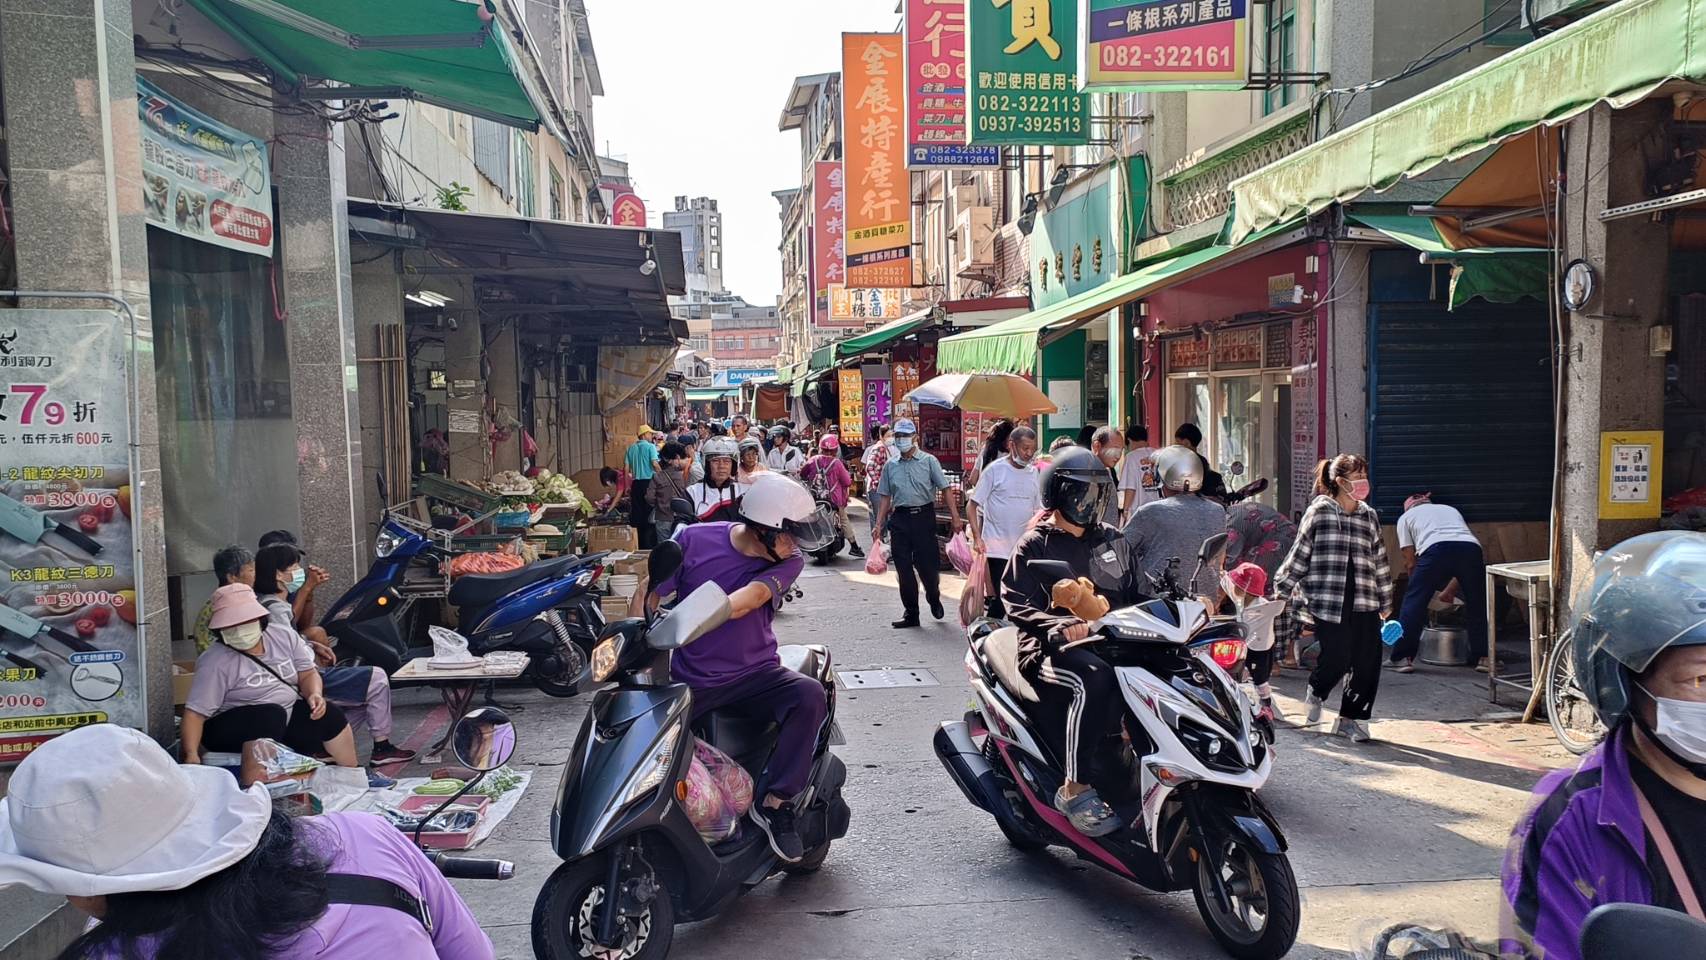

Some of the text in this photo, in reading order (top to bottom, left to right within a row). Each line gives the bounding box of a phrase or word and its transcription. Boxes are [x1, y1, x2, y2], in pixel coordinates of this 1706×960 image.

[1107, 0, 1231, 32] 一條根系列產品
[1102, 45, 1229, 67] 082-322161
[979, 96, 1080, 112] 082-322113
[856, 40, 899, 222] 金展特產行
[979, 116, 1080, 132] 0937-392513
[930, 145, 996, 155] 082-323378
[931, 155, 996, 164] 0988212661
[616, 199, 642, 225] 金
